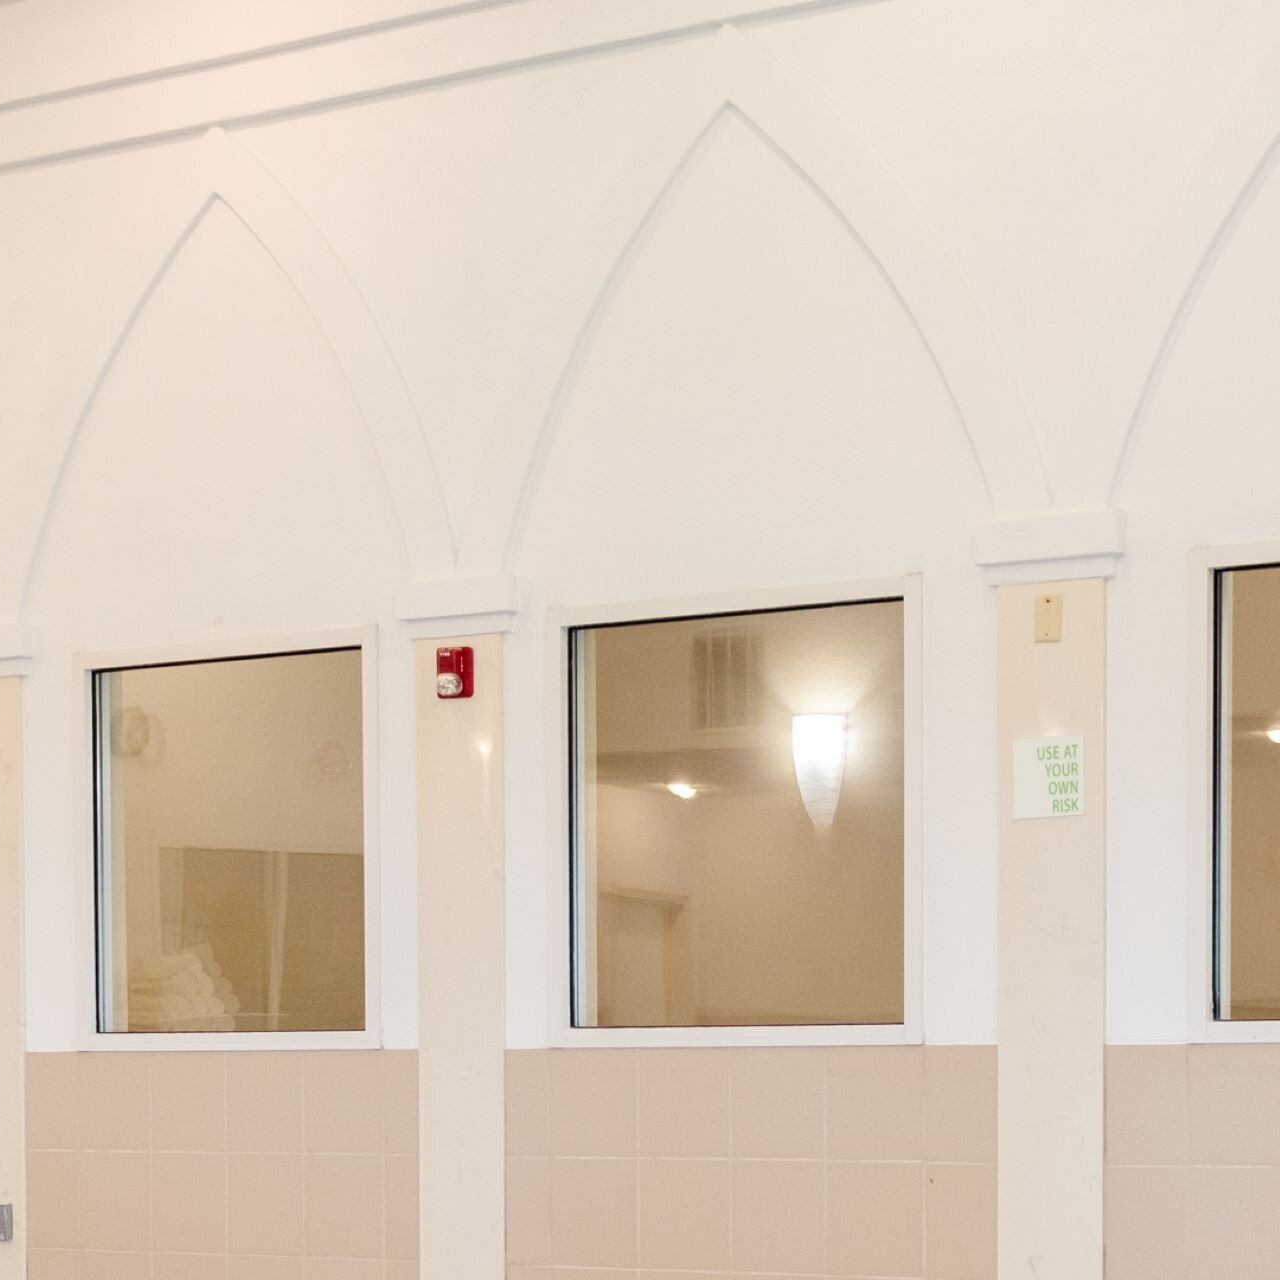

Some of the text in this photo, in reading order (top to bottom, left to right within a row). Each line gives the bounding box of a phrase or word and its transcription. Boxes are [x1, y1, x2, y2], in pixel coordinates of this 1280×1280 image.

[1036, 743, 1079, 761] USE AT
[1044, 762, 1079, 777] YOUR
[1048, 780, 1078, 795] OWN
[1052, 798, 1079, 813] RISK
